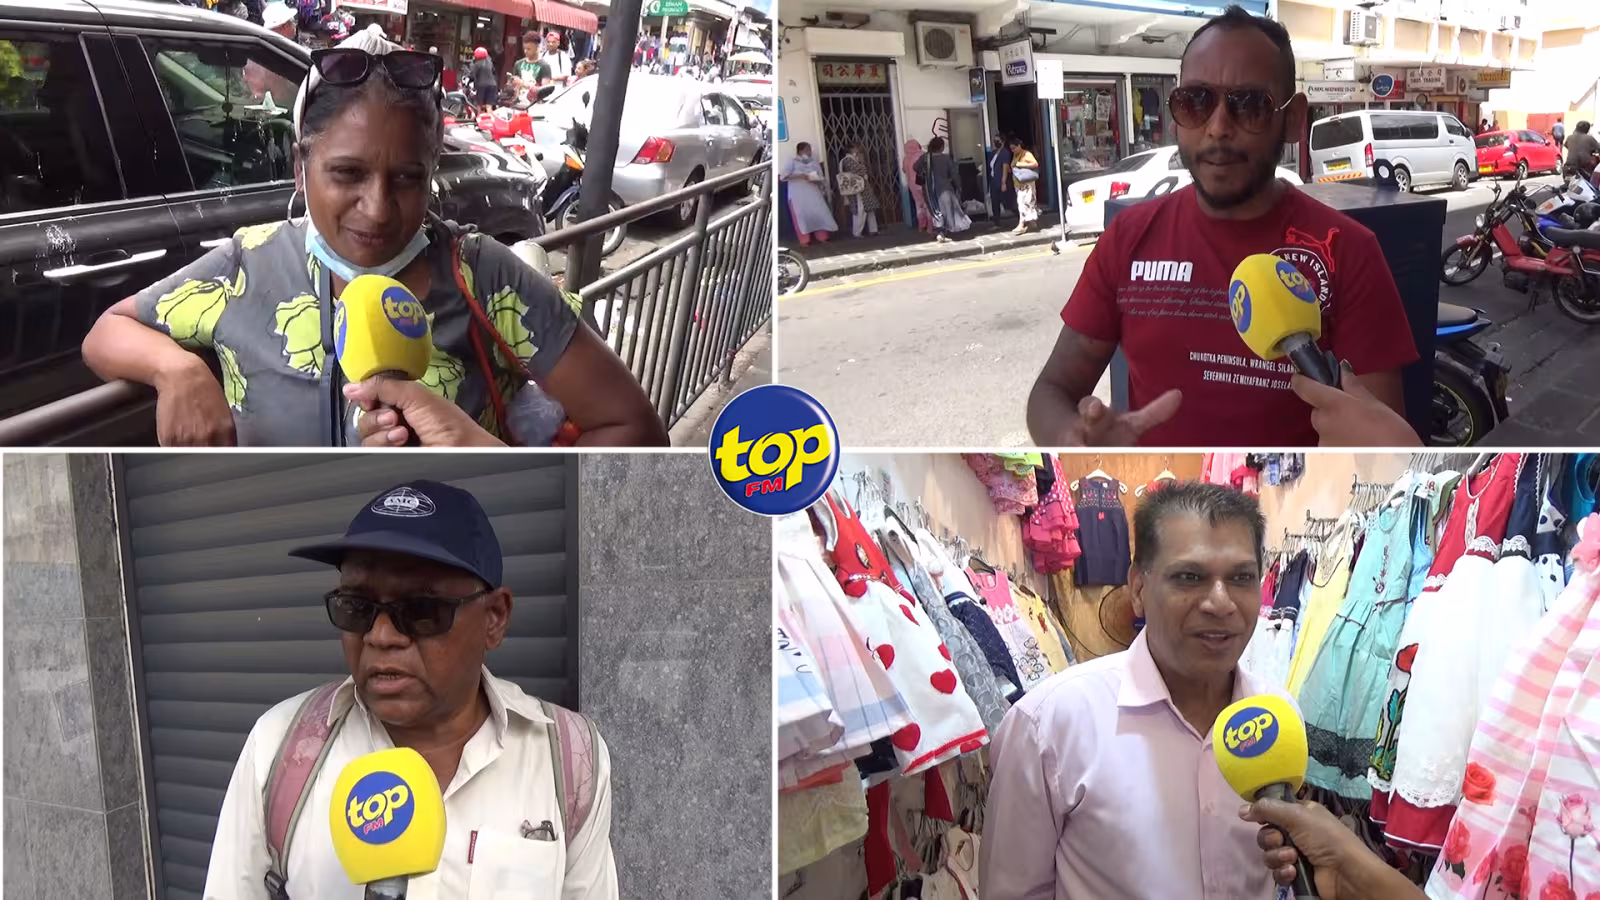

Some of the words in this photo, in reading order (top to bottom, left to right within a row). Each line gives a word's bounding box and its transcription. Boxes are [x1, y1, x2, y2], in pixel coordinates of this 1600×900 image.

[1130, 260, 1193, 282] PUMA
[1284, 253, 1308, 263] NEW
[1309, 259, 1329, 302] ISLAND
[1249, 358, 1277, 372] WRANGEL
[1225, 712, 1274, 750] top
[347, 785, 409, 828] top
[363, 817, 384, 835] FM
